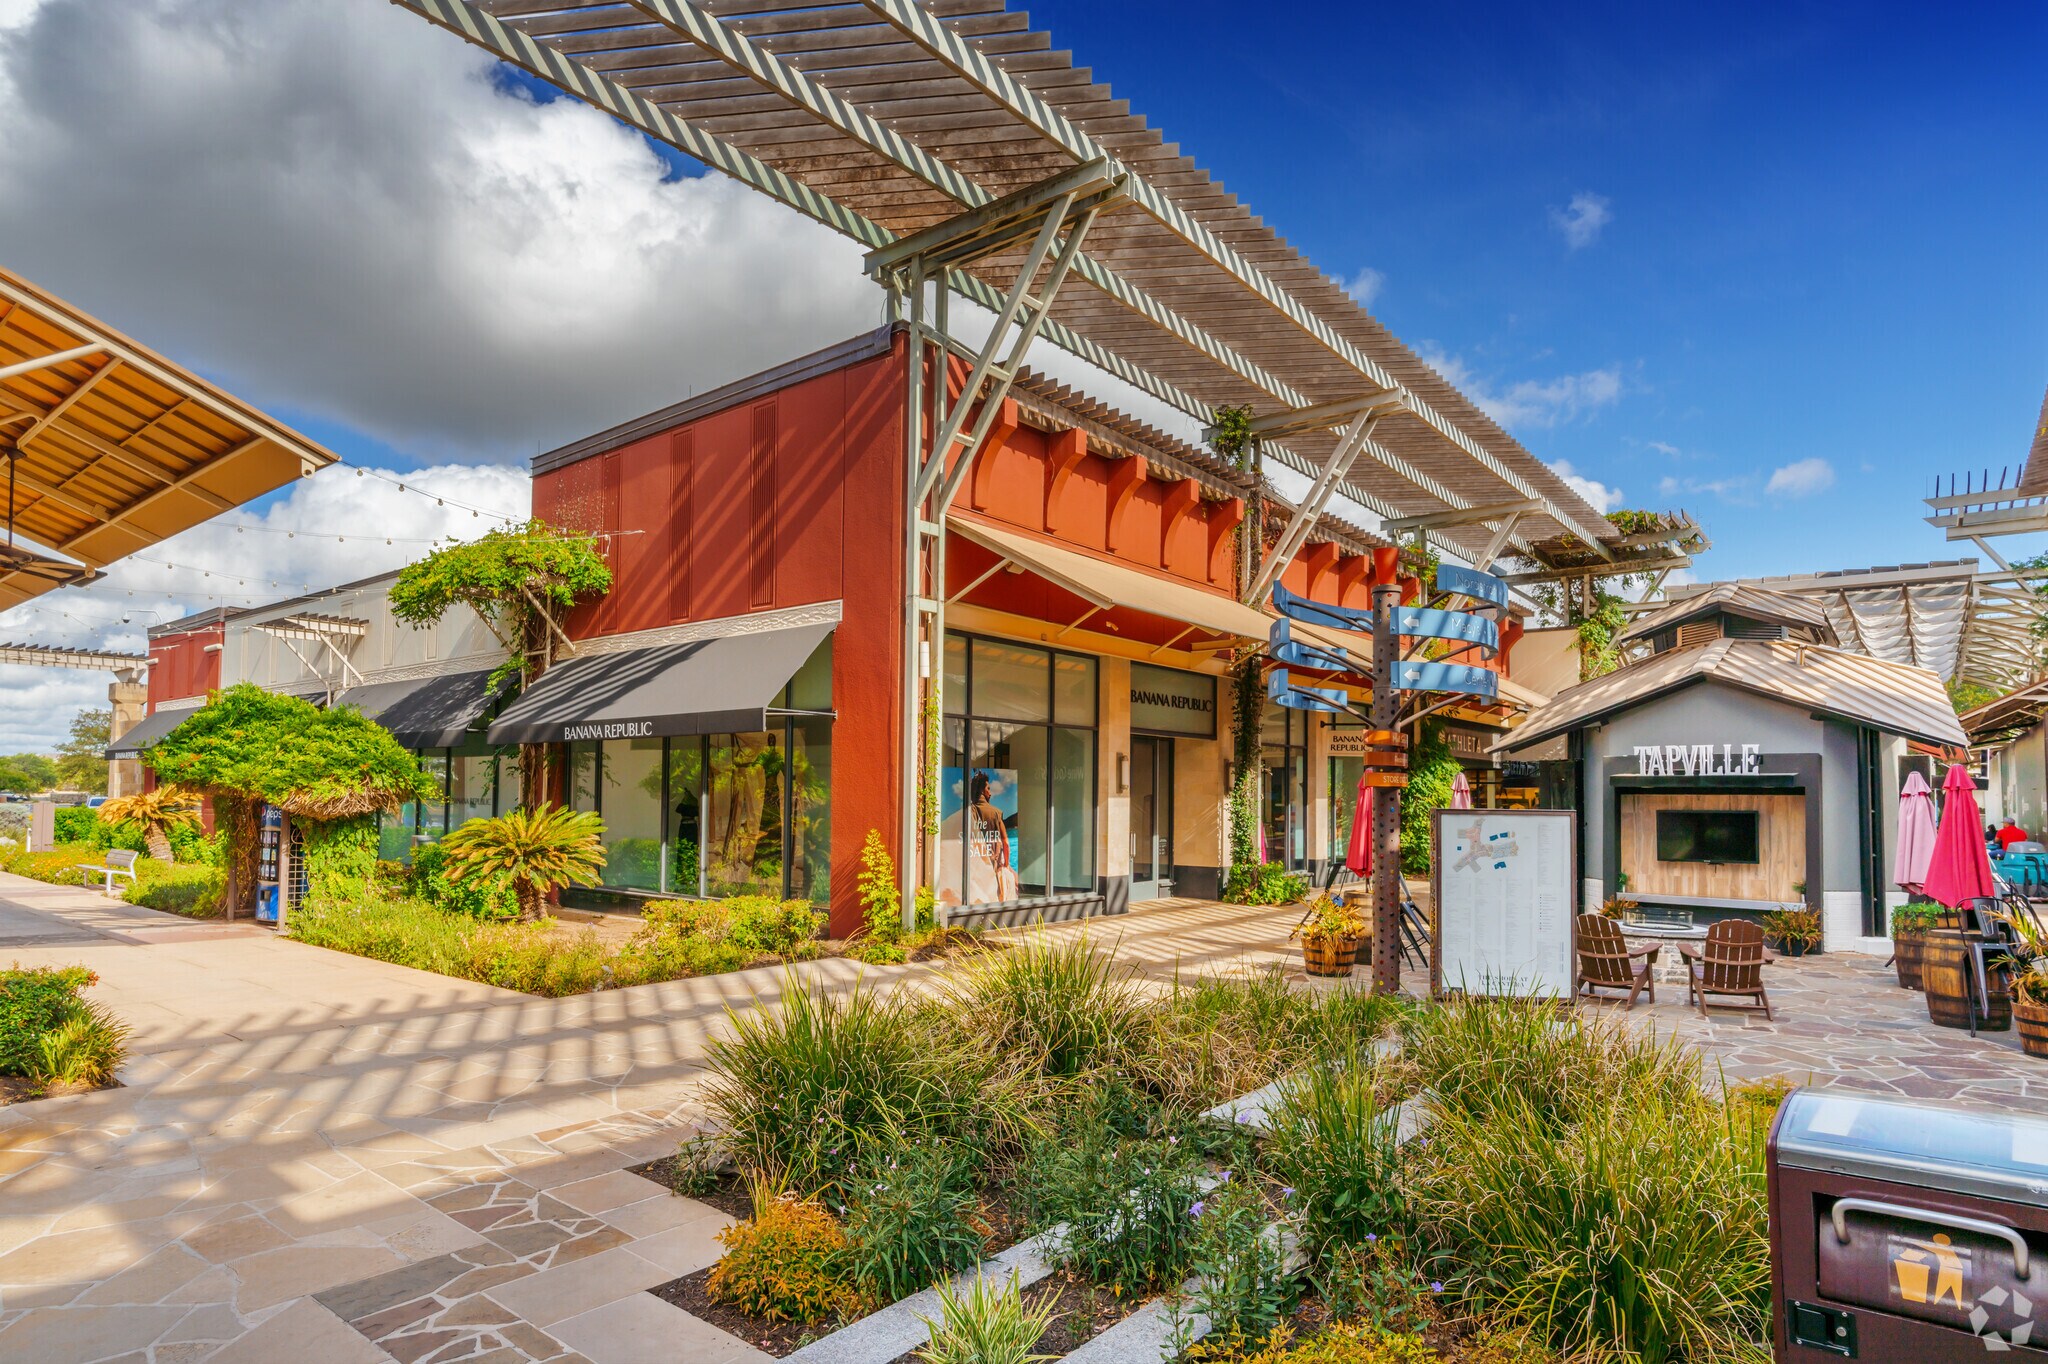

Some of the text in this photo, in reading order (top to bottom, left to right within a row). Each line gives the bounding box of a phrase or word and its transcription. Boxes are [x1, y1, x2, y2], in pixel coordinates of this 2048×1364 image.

[1130, 689, 1212, 713] BANANA REPUBLIC
[564, 721, 653, 740] BANANA REPUBLIC
[1633, 743, 1760, 776] TAPVILLE
[266, 809, 281, 819] peps
[973, 819, 988, 830] the
[958, 830, 1002, 845] SMMER
[969, 843, 993, 858] SALE
